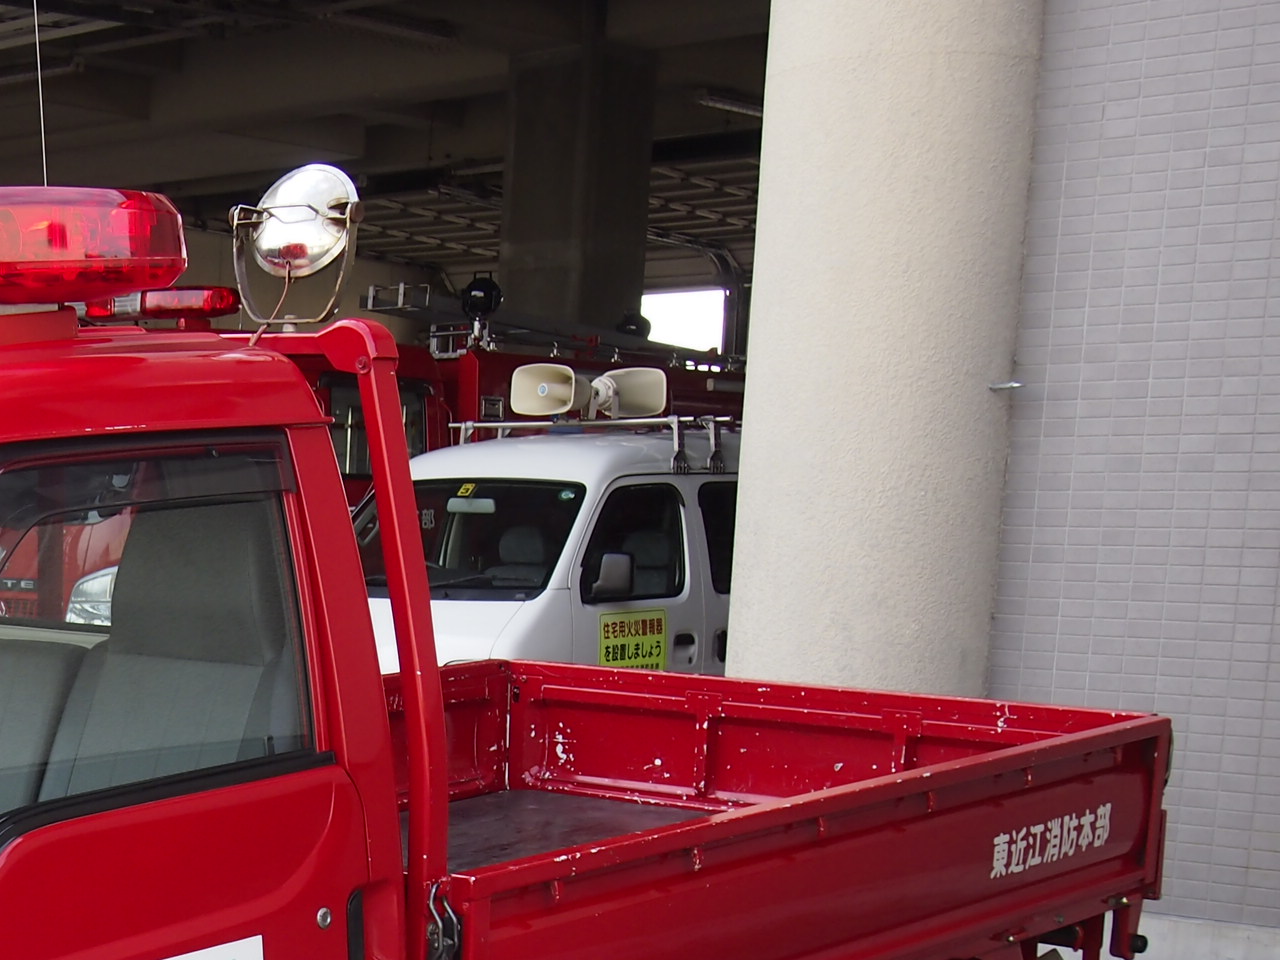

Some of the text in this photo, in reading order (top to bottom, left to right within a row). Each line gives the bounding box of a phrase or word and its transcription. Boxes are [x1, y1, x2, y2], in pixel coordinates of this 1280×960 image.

[603, 618, 663, 639] 住宅用火災警報器
[604, 641, 661, 662] を設置しましょう
[990, 803, 1111, 879] 東近江消防本部
